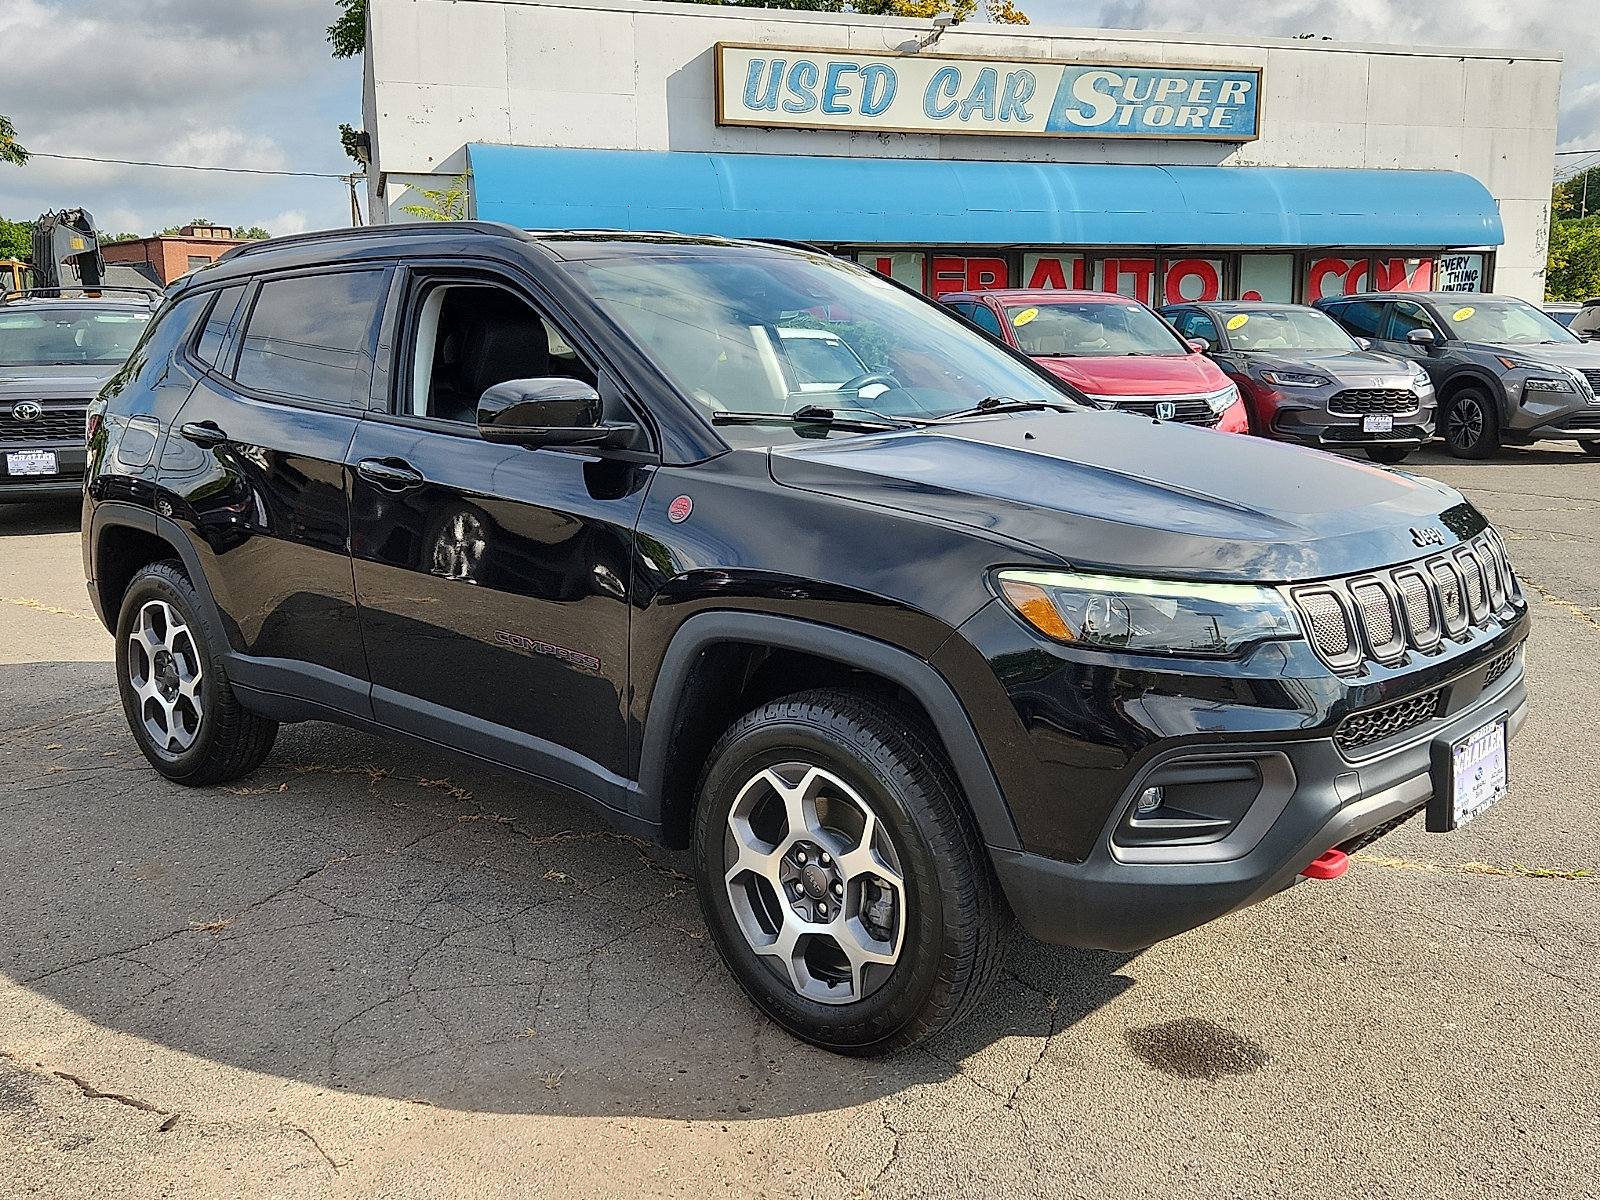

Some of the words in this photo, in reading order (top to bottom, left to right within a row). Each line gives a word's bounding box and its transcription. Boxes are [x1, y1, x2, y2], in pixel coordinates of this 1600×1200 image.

[741, 57, 899, 118] USED
[922, 64, 1037, 123] CAR
[1440, 256, 1470, 274] EVERY
[1447, 269, 1479, 284] THING
[1408, 527, 1445, 547] Jeep
[493, 629, 601, 671] COMPASS
